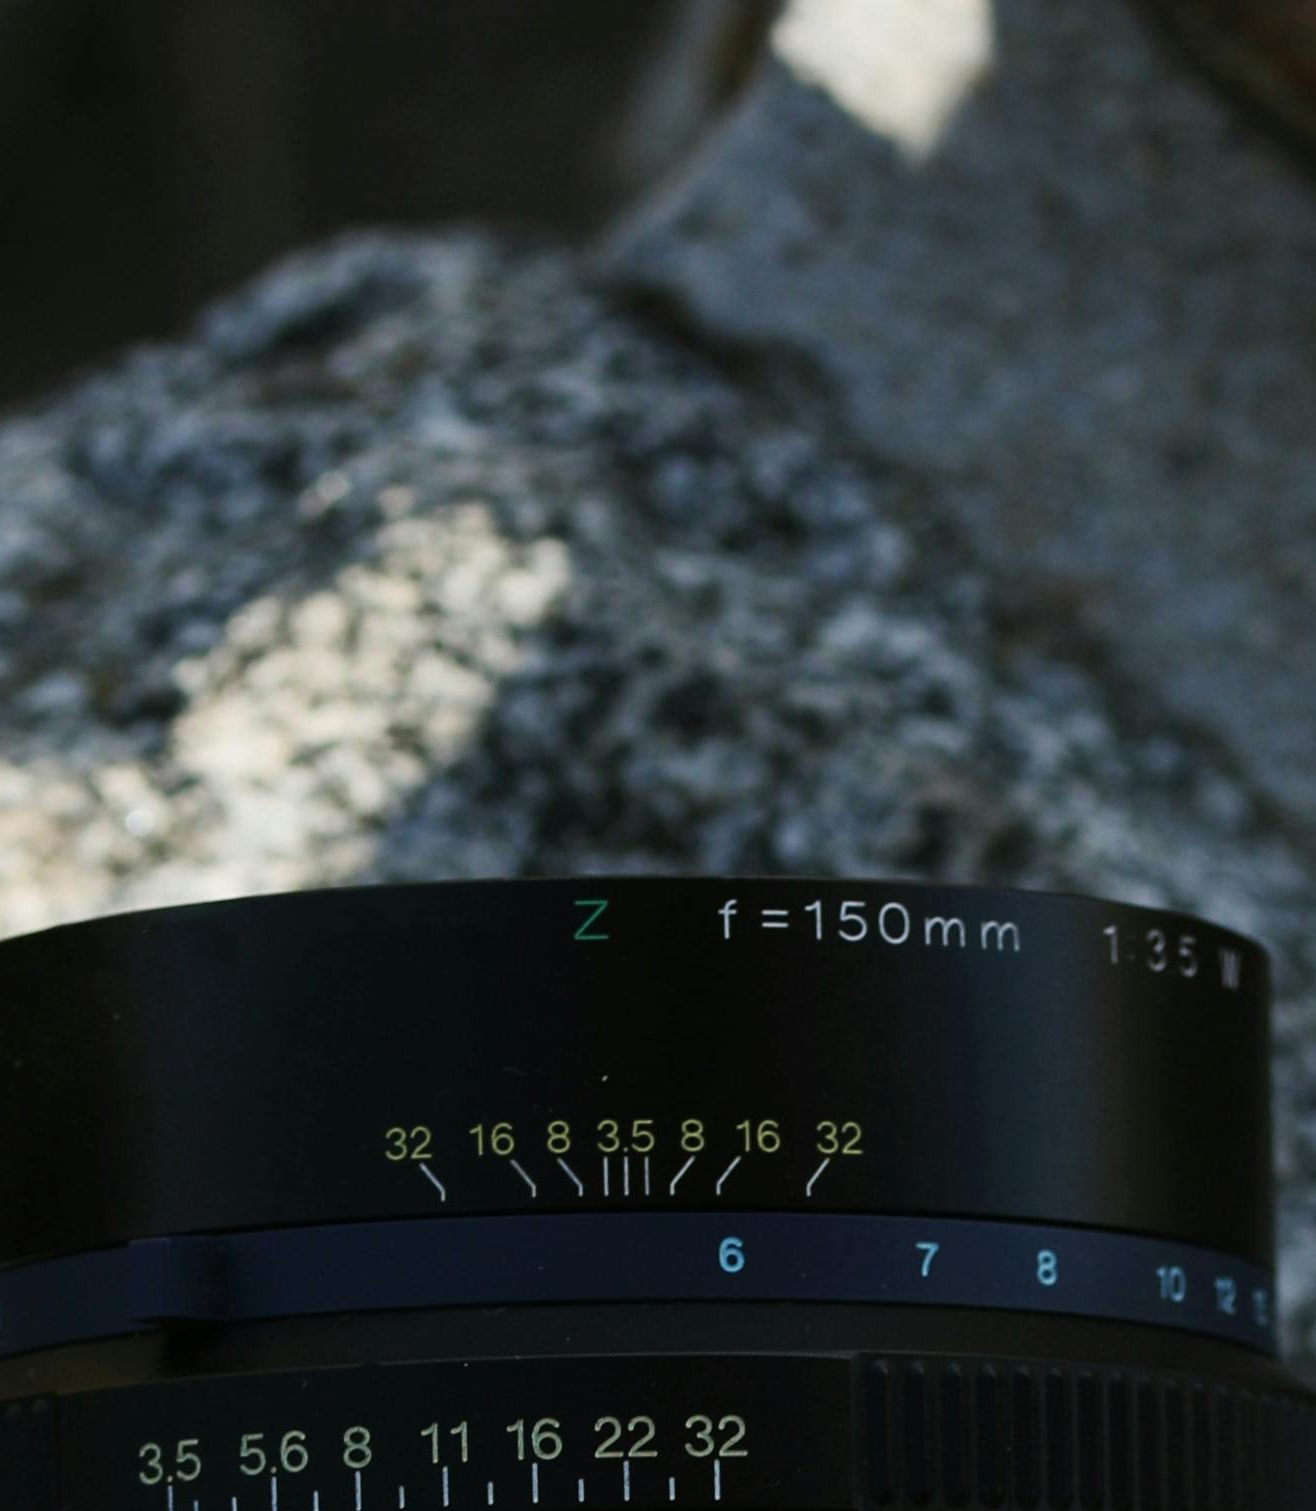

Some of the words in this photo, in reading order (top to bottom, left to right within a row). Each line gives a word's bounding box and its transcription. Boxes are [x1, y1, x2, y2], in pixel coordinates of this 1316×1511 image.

[573, 899, 609, 941] Z
[385, 1125, 433, 1161] 32
[469, 1122, 515, 1156] 16
[547, 1120, 571, 1154] 8
[597, 1119, 655, 1153] 3.5
[680, 1118, 705, 1152] 8
[736, 1119, 781, 1153] 16
[816, 1120, 863, 1155] 32
[718, 1236, 745, 1273] 6
[915, 1242, 939, 1277] 7
[1037, 1249, 1057, 1286] 8
[1156, 1266, 1185, 1302] 10
[139, 1438, 202, 1485] 3.5
[240, 1430, 309, 1475] 5.6
[343, 1426, 372, 1469] 8
[420, 1421, 469, 1464] 11
[506, 1417, 563, 1462] 16
[594, 1415, 658, 1459] 22
[684, 1414, 749, 1458] 32
